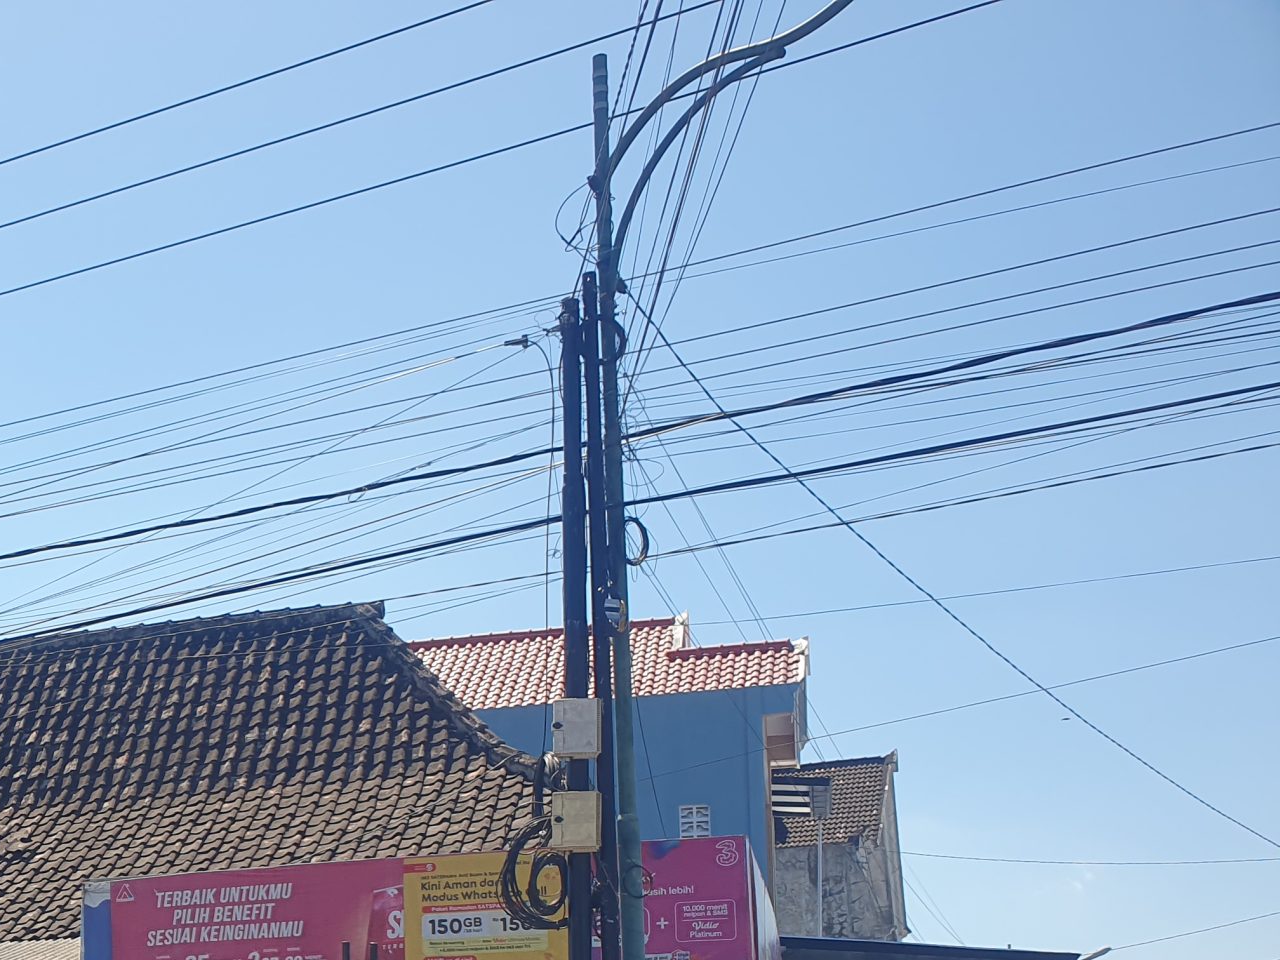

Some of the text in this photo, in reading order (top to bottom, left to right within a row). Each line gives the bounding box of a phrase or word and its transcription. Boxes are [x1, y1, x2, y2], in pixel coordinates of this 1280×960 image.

[421, 882, 440, 891] Kini
[444, 879, 477, 889] Aman
[669, 885, 694, 895] lebih!
[156, 883, 292, 908] TERBAIK UNTUKMU
[422, 893, 459, 902] Modus
[173, 903, 275, 925] PILIH BENEFIT
[428, 918, 462, 935] 150
[463, 917, 482, 928] GB
[692, 921, 719, 930] Vidio
[147, 921, 304, 947] SESUAI KEINGINANMU
[690, 931, 722, 939] Platinum
